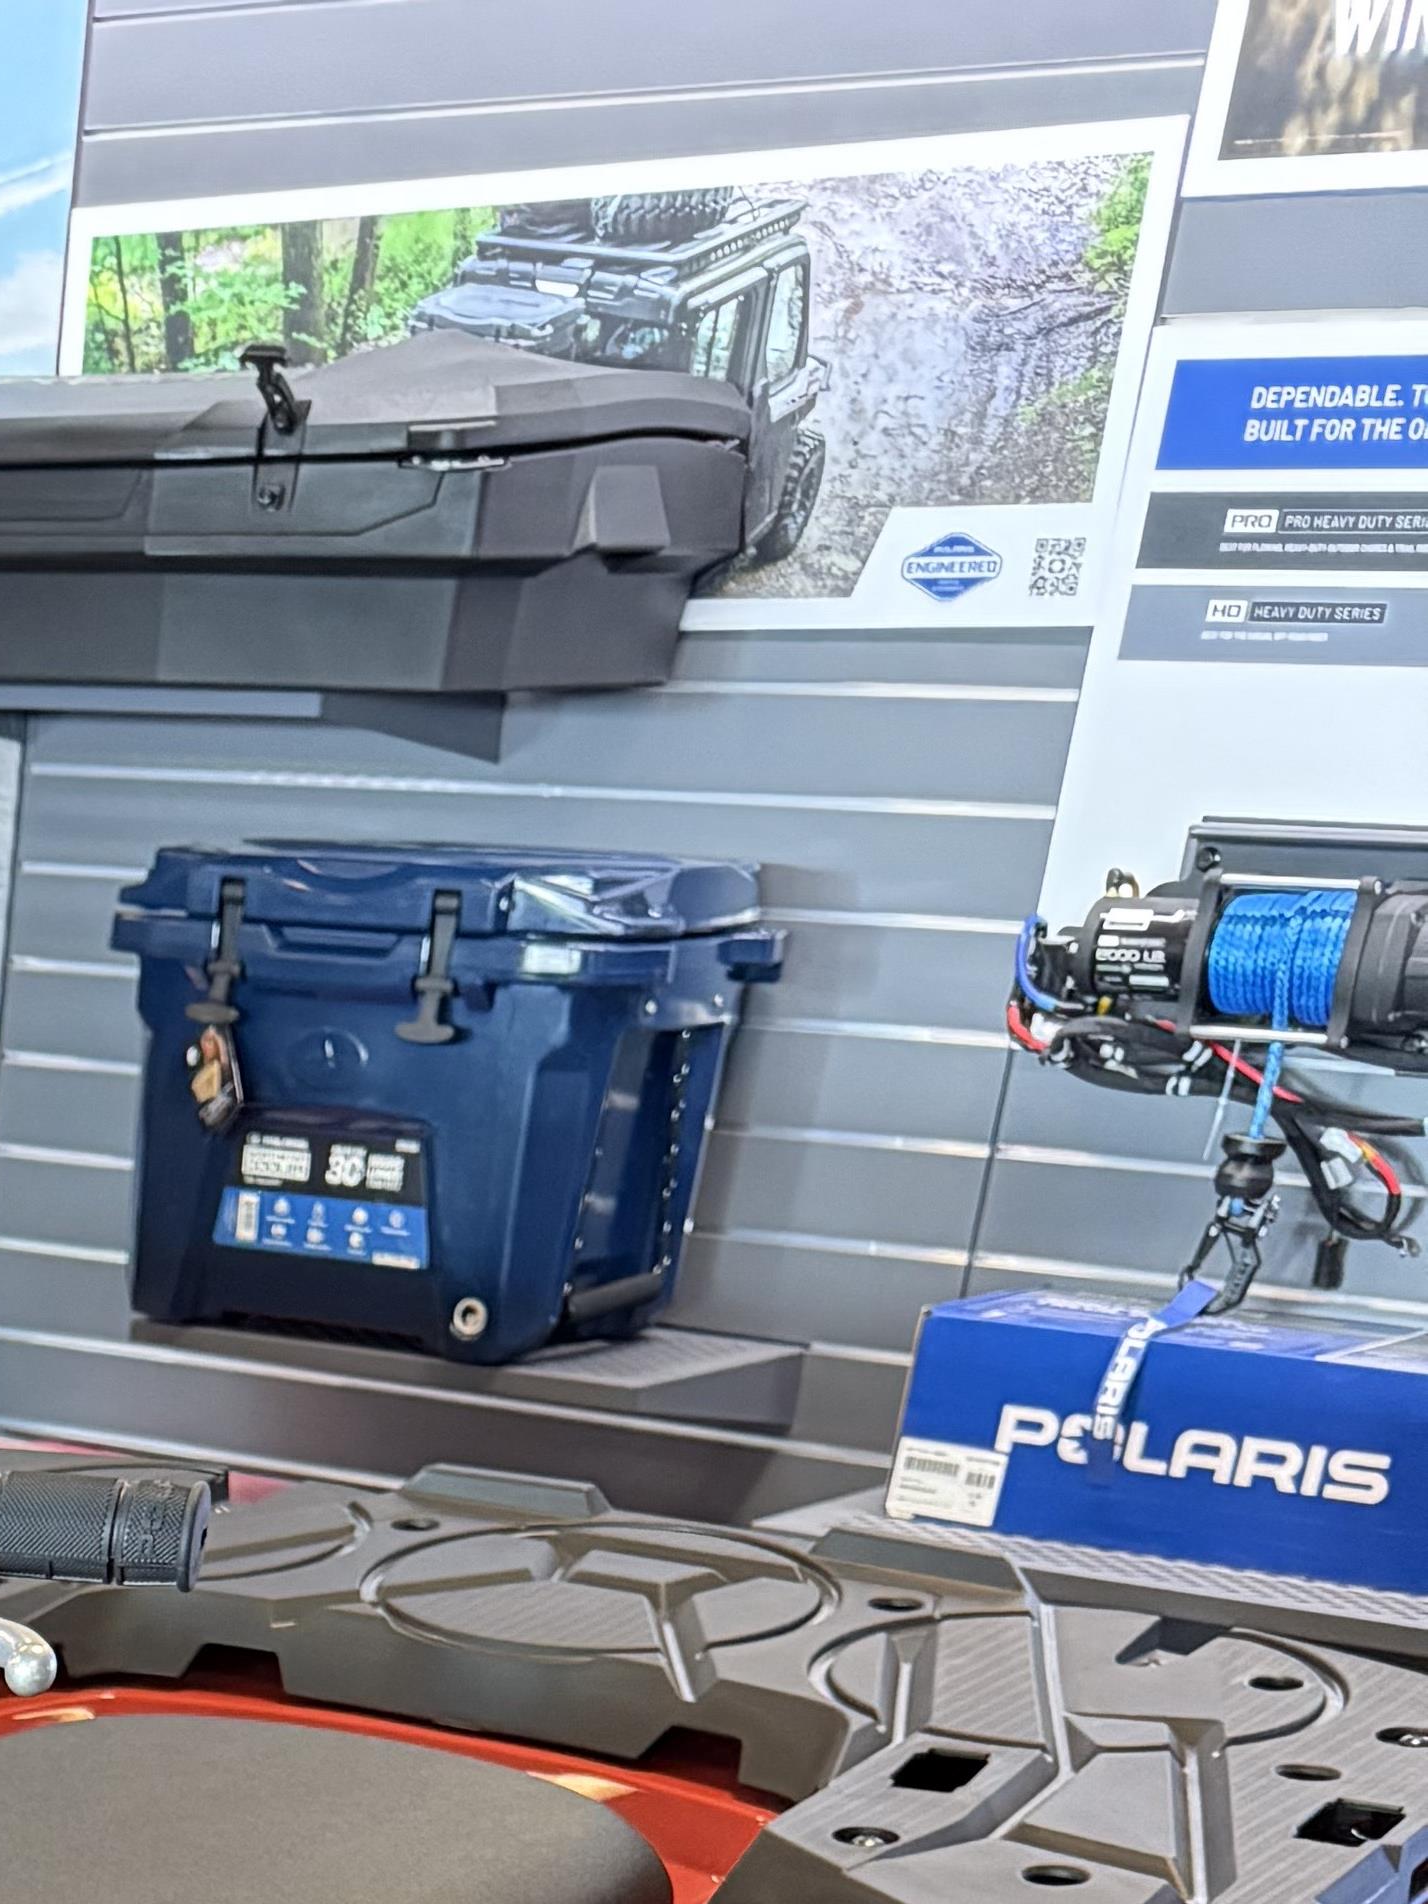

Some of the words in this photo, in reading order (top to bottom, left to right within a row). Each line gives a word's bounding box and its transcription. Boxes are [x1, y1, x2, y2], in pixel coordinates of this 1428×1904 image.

[1250, 384, 1404, 409] DEPENDABLE.
[1244, 419, 1309, 441] BUILT
[1310, 418, 1356, 441] FOR
[1361, 418, 1406, 441] THE
[1231, 514, 1273, 528] PRO
[1284, 515, 1310, 528] PRO
[1313, 515, 1356, 528] HEAVY
[1358, 515, 1393, 529] DUTY
[906, 560, 997, 574] ENGINEERED
[1212, 604, 1241, 618] HD
[1254, 606, 1294, 618] HEAVY
[1298, 606, 1332, 619] DUTY
[1334, 607, 1382, 620] SERIES
